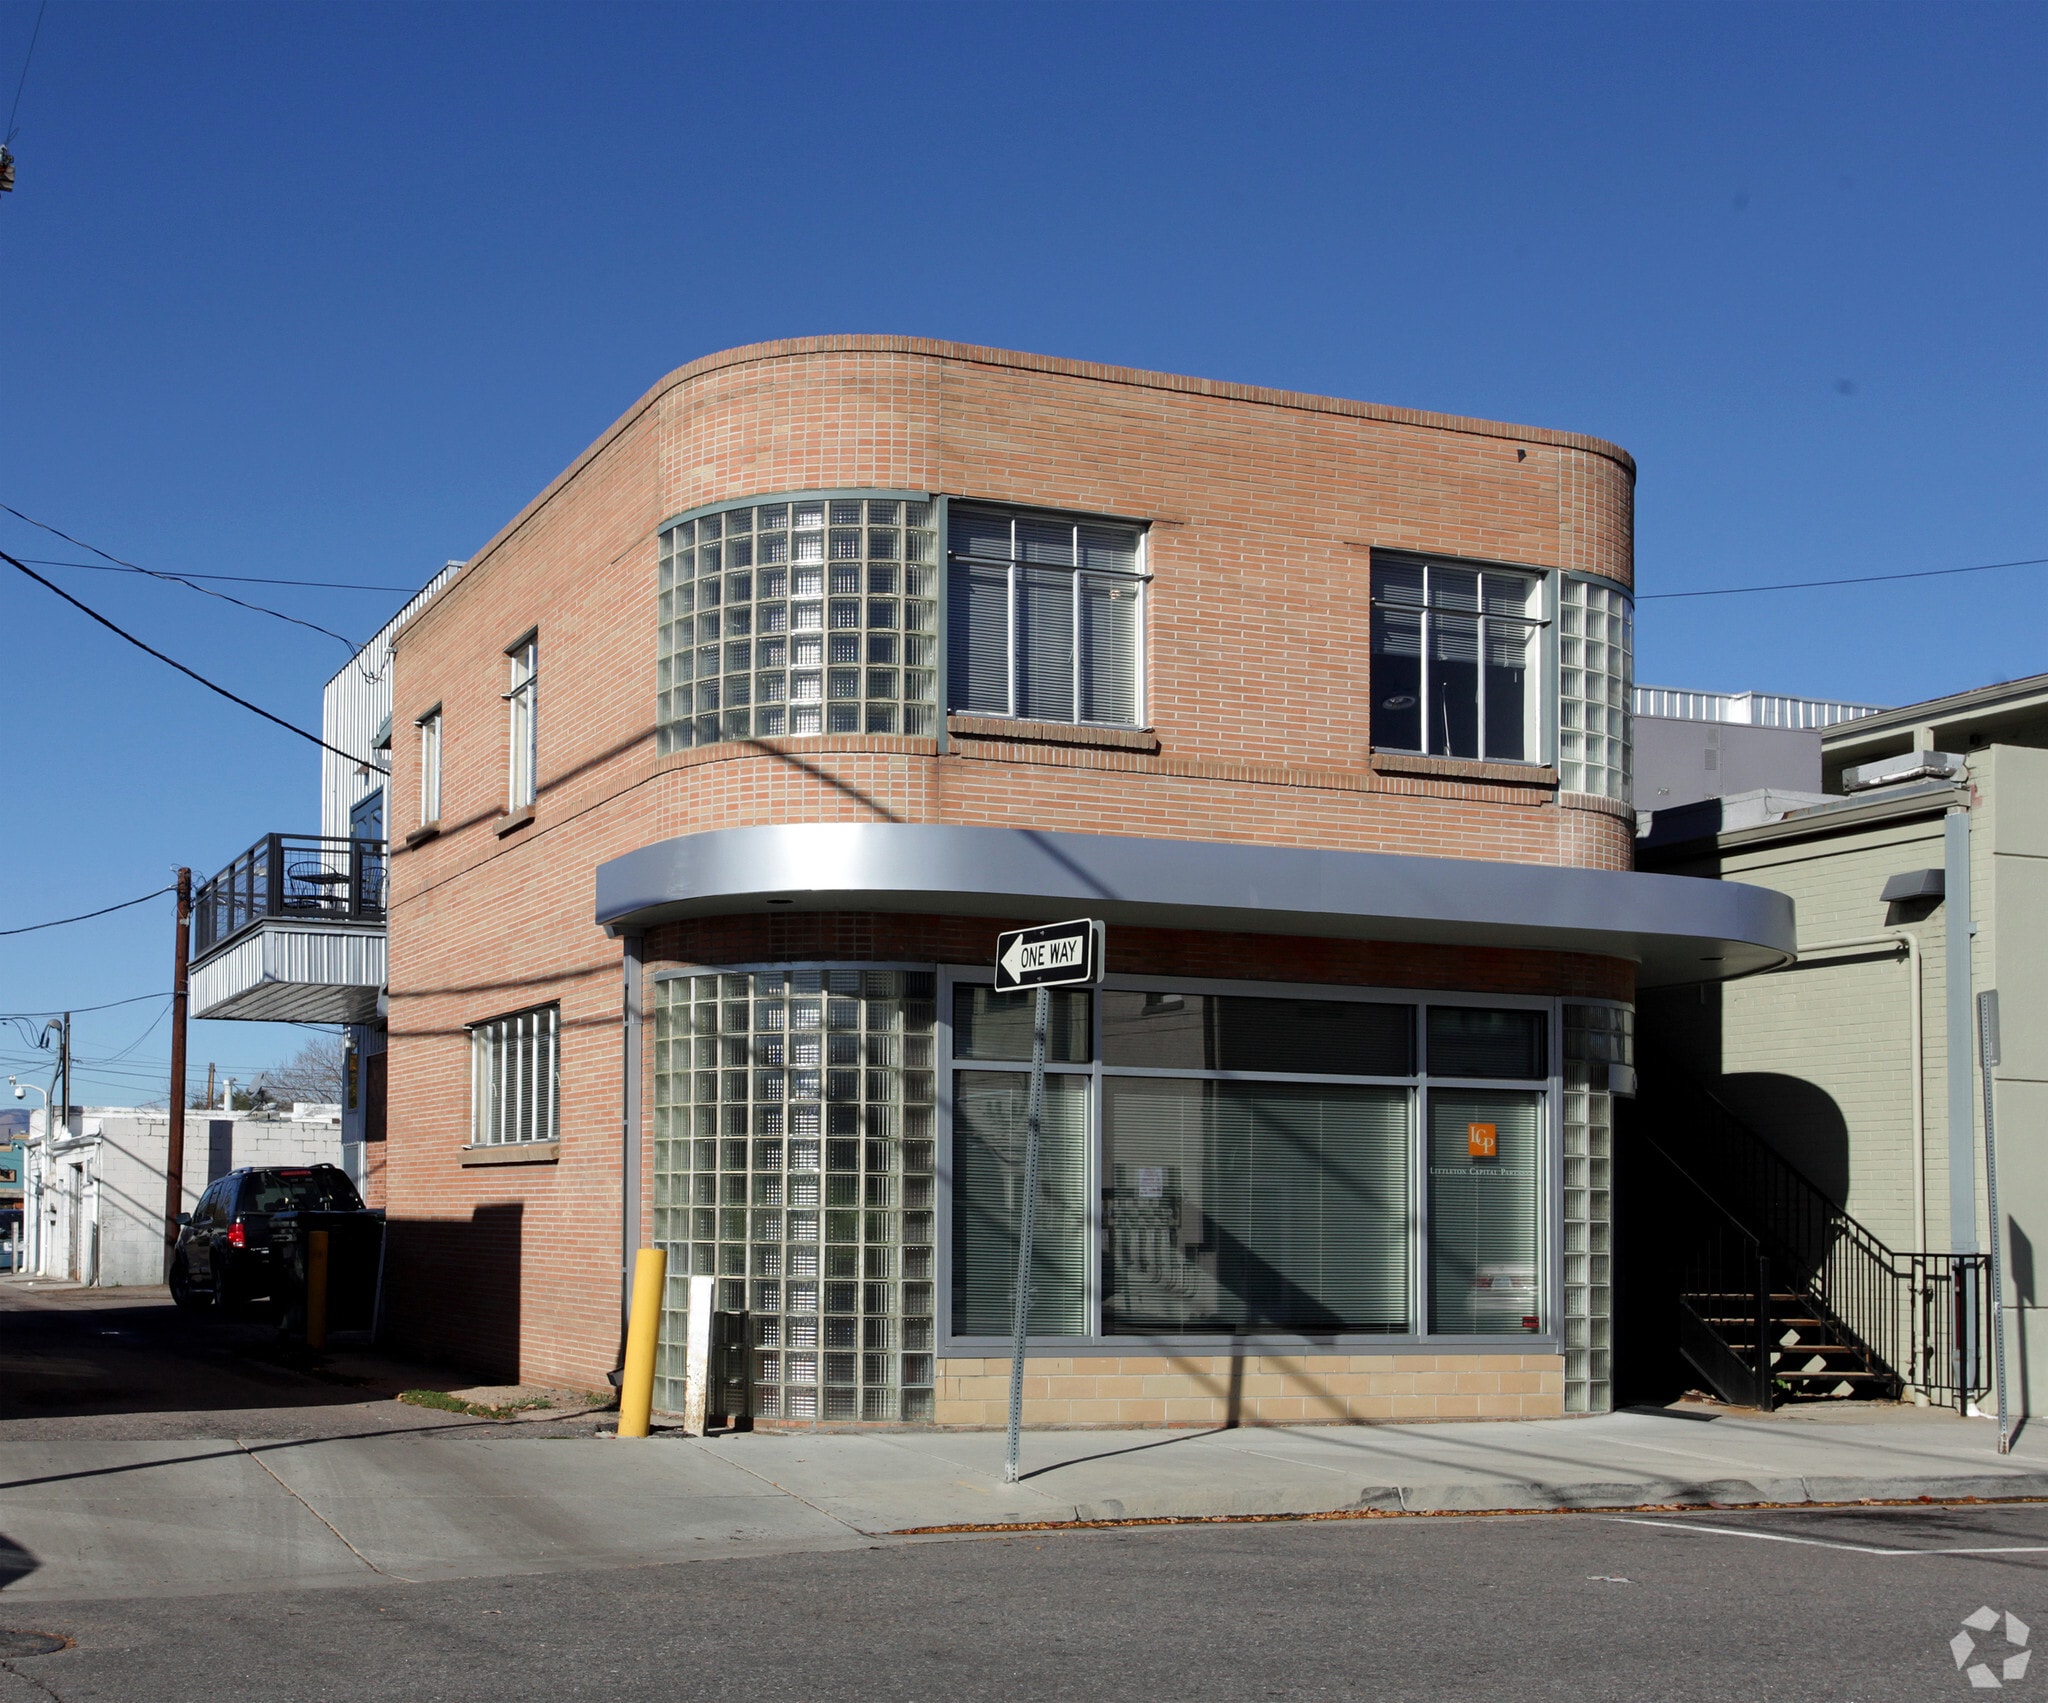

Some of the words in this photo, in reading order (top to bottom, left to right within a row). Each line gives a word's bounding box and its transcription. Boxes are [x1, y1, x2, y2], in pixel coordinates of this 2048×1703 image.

[1021, 945, 1045, 968] ONE
[1050, 940, 1077, 965] WAY
[1470, 1126, 1494, 1154] LCP
